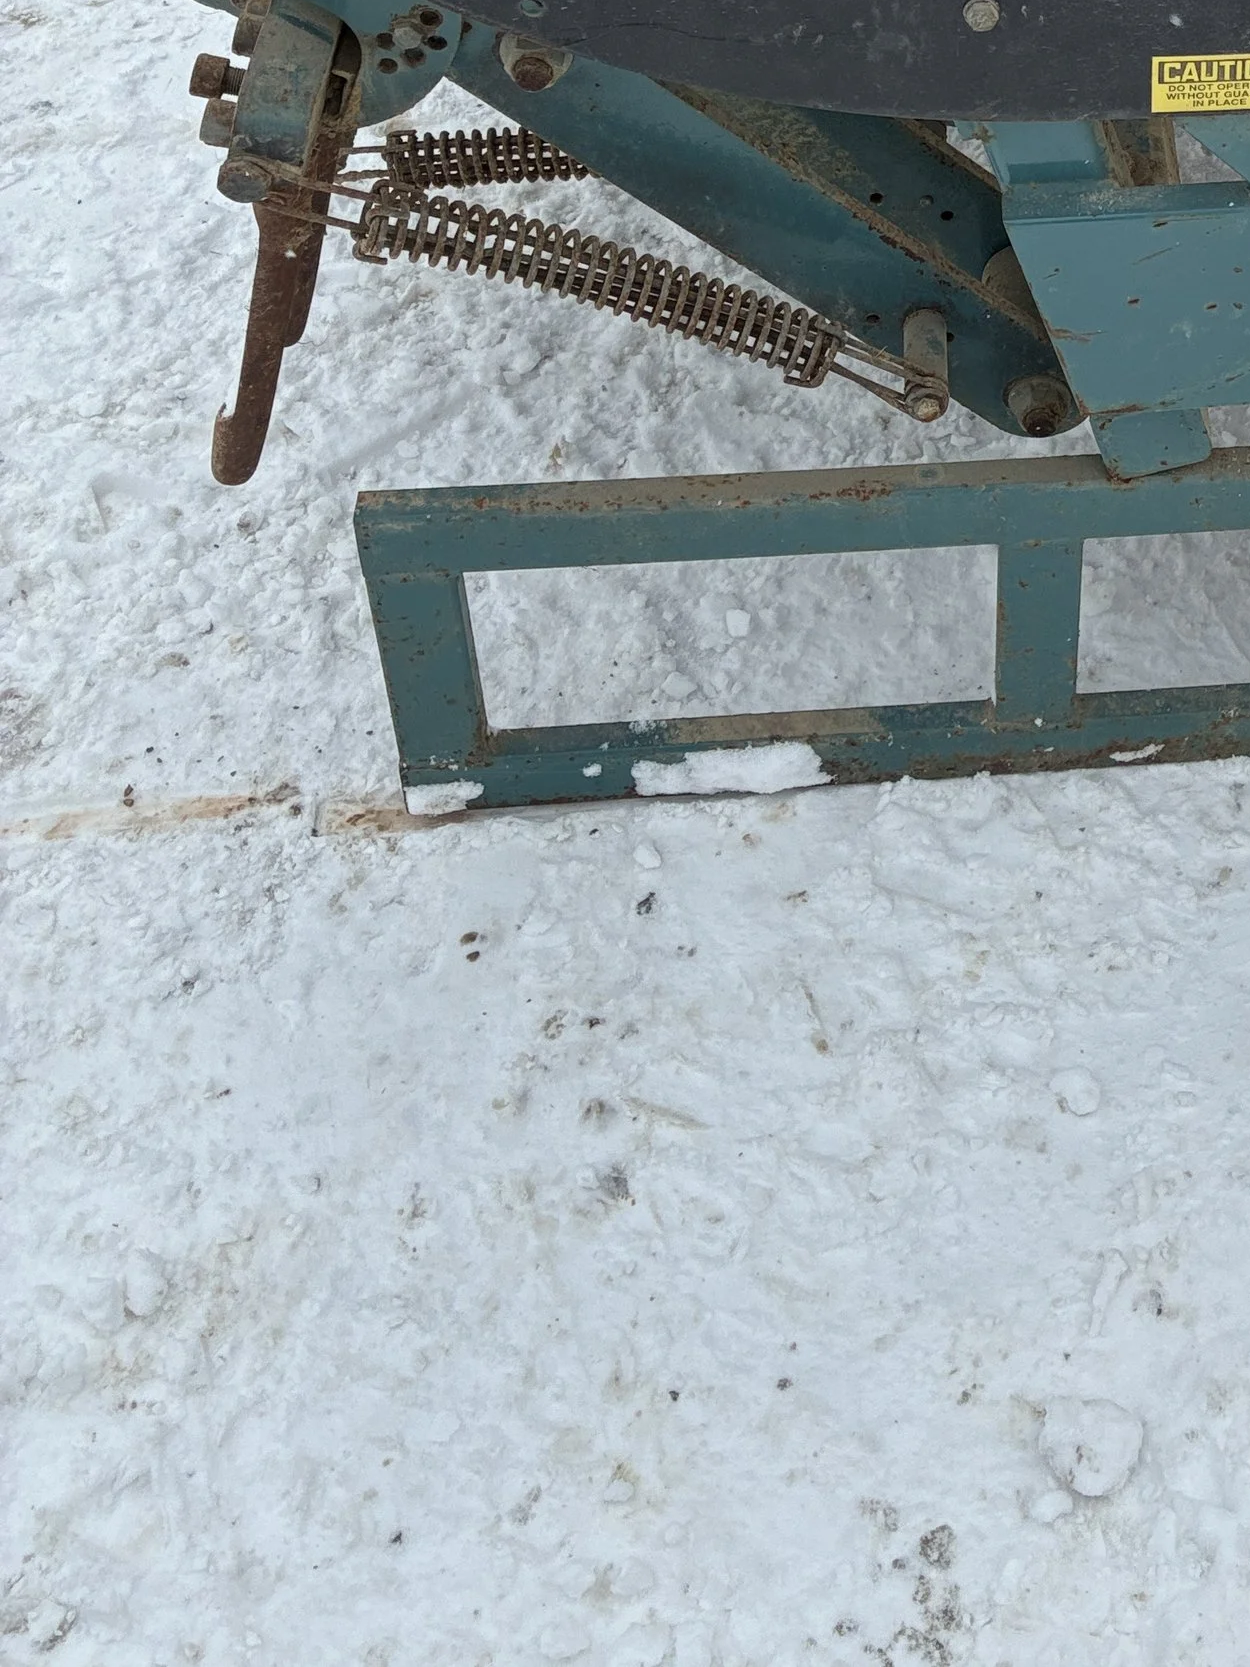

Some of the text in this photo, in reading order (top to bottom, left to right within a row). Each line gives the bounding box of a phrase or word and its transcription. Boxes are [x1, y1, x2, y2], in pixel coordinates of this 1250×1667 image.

[1189, 84, 1213, 92] NOT
[1166, 91, 1221, 100] WITHOUT
[1207, 98, 1247, 107] PLACE
